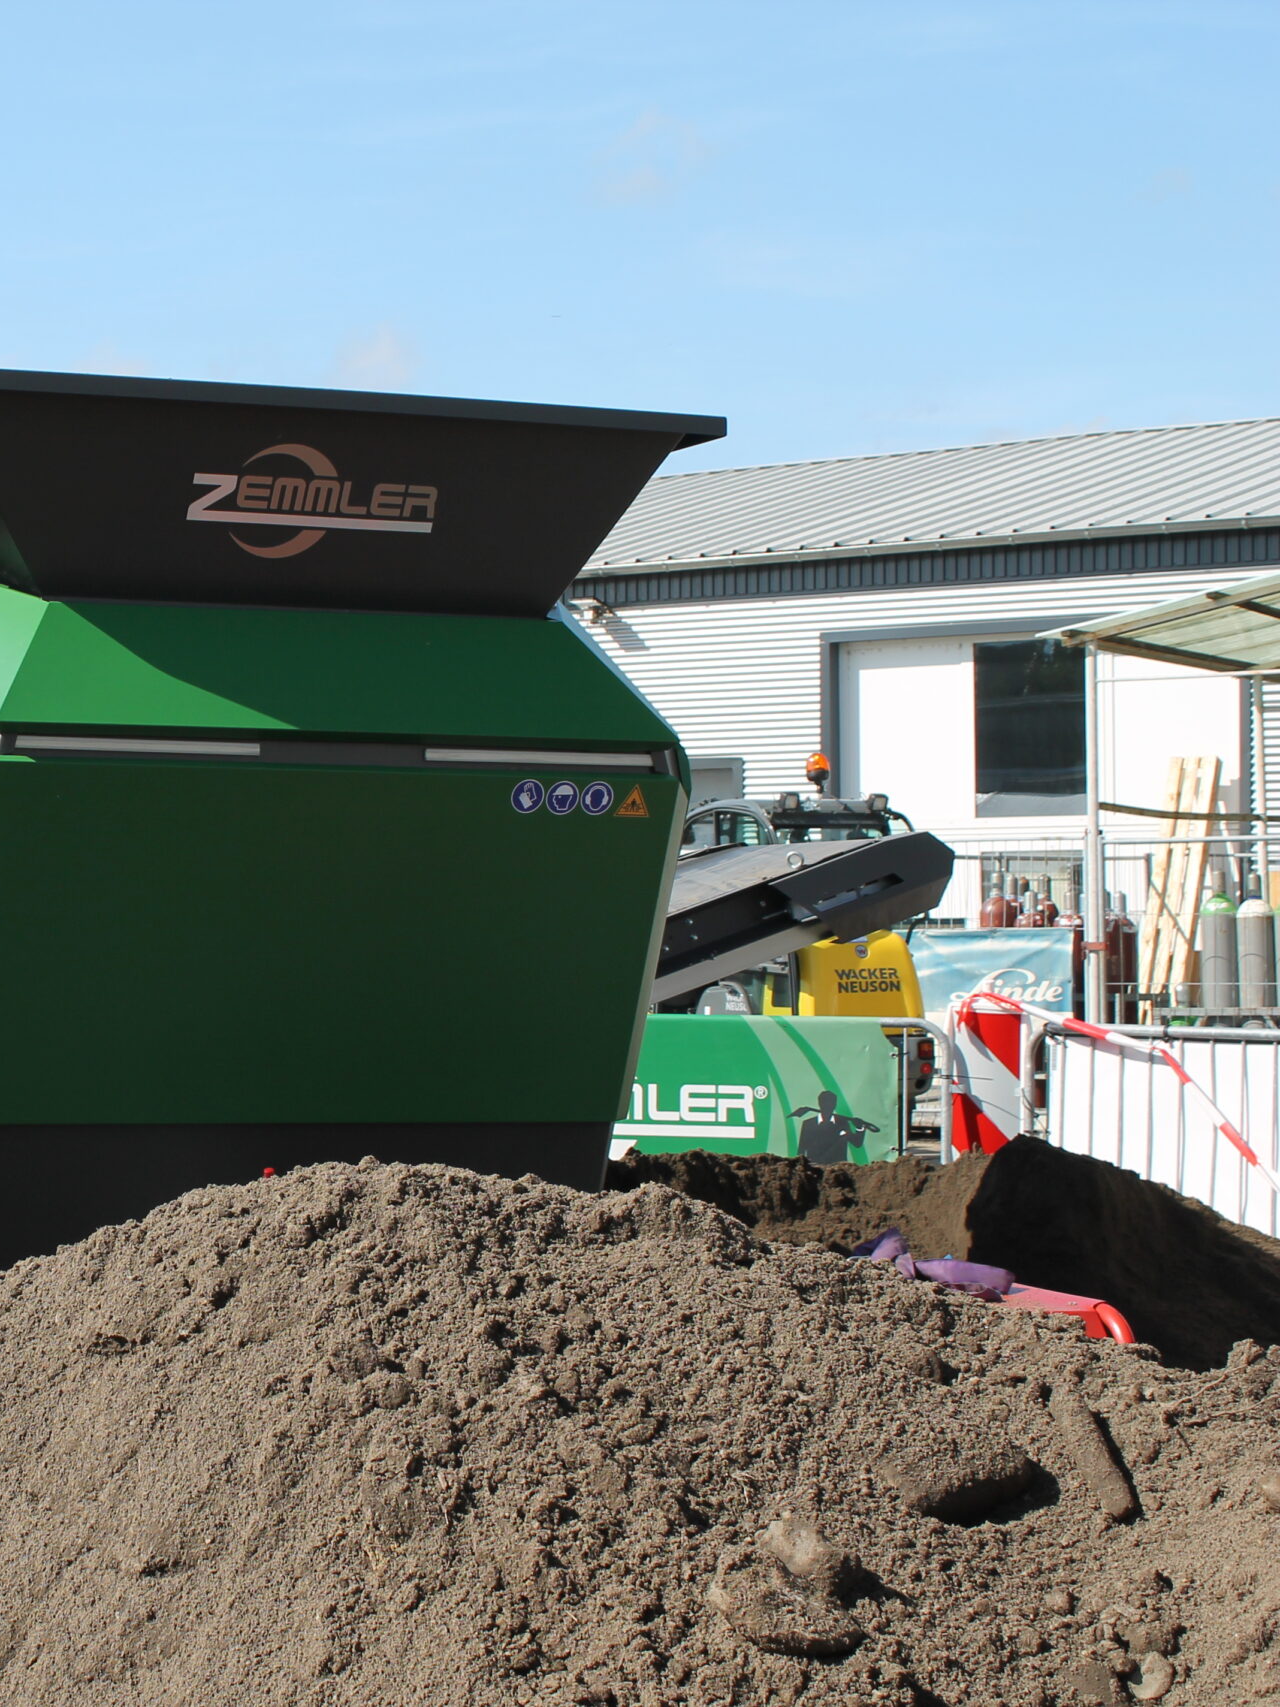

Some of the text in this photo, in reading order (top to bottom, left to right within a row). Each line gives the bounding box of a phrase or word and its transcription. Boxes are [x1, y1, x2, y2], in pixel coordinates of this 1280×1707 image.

[186, 472, 439, 533] ZEMMLER
[835, 968, 900, 980] WACKER
[837, 980, 901, 994] NEUSON
